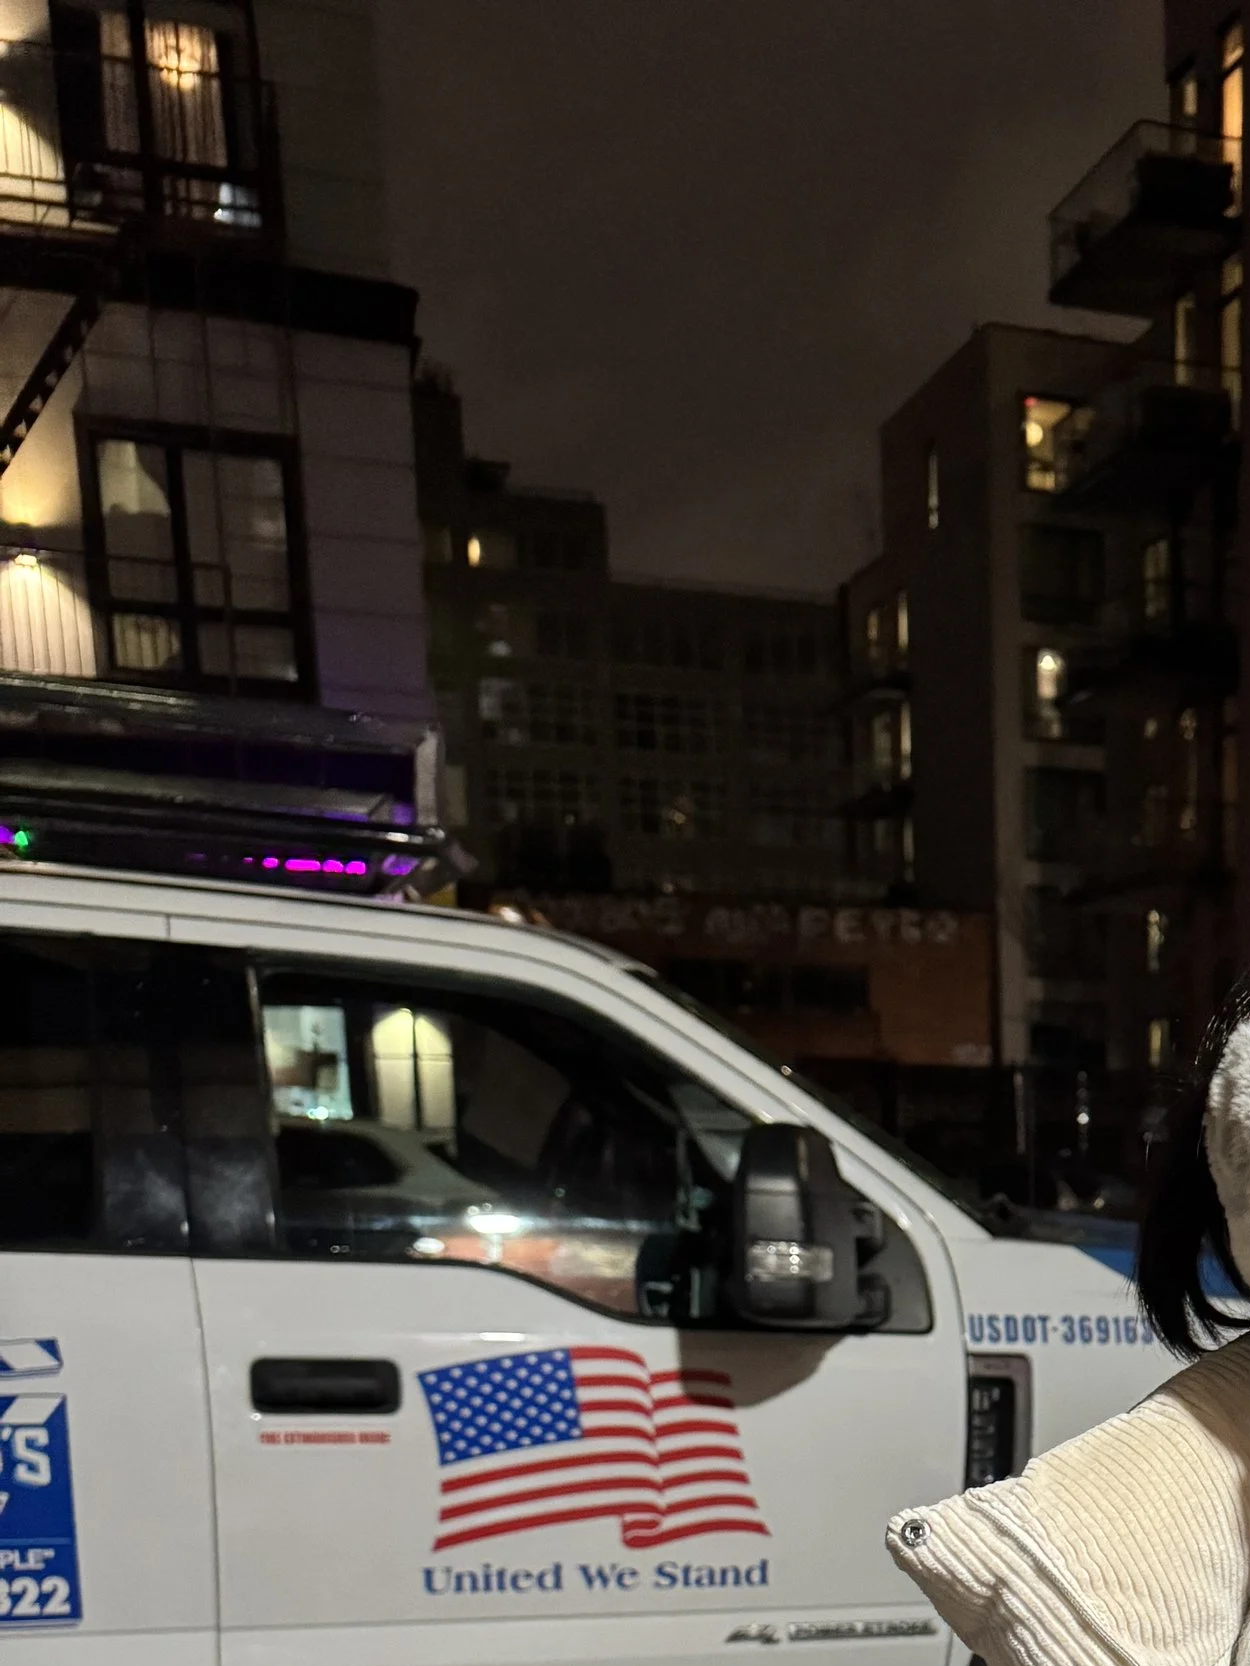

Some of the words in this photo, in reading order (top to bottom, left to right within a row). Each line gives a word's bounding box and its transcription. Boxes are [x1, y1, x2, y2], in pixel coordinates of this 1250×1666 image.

[422, 1561, 565, 1597] United
[578, 1562, 641, 1593] We
[652, 1557, 770, 1591] Stand
